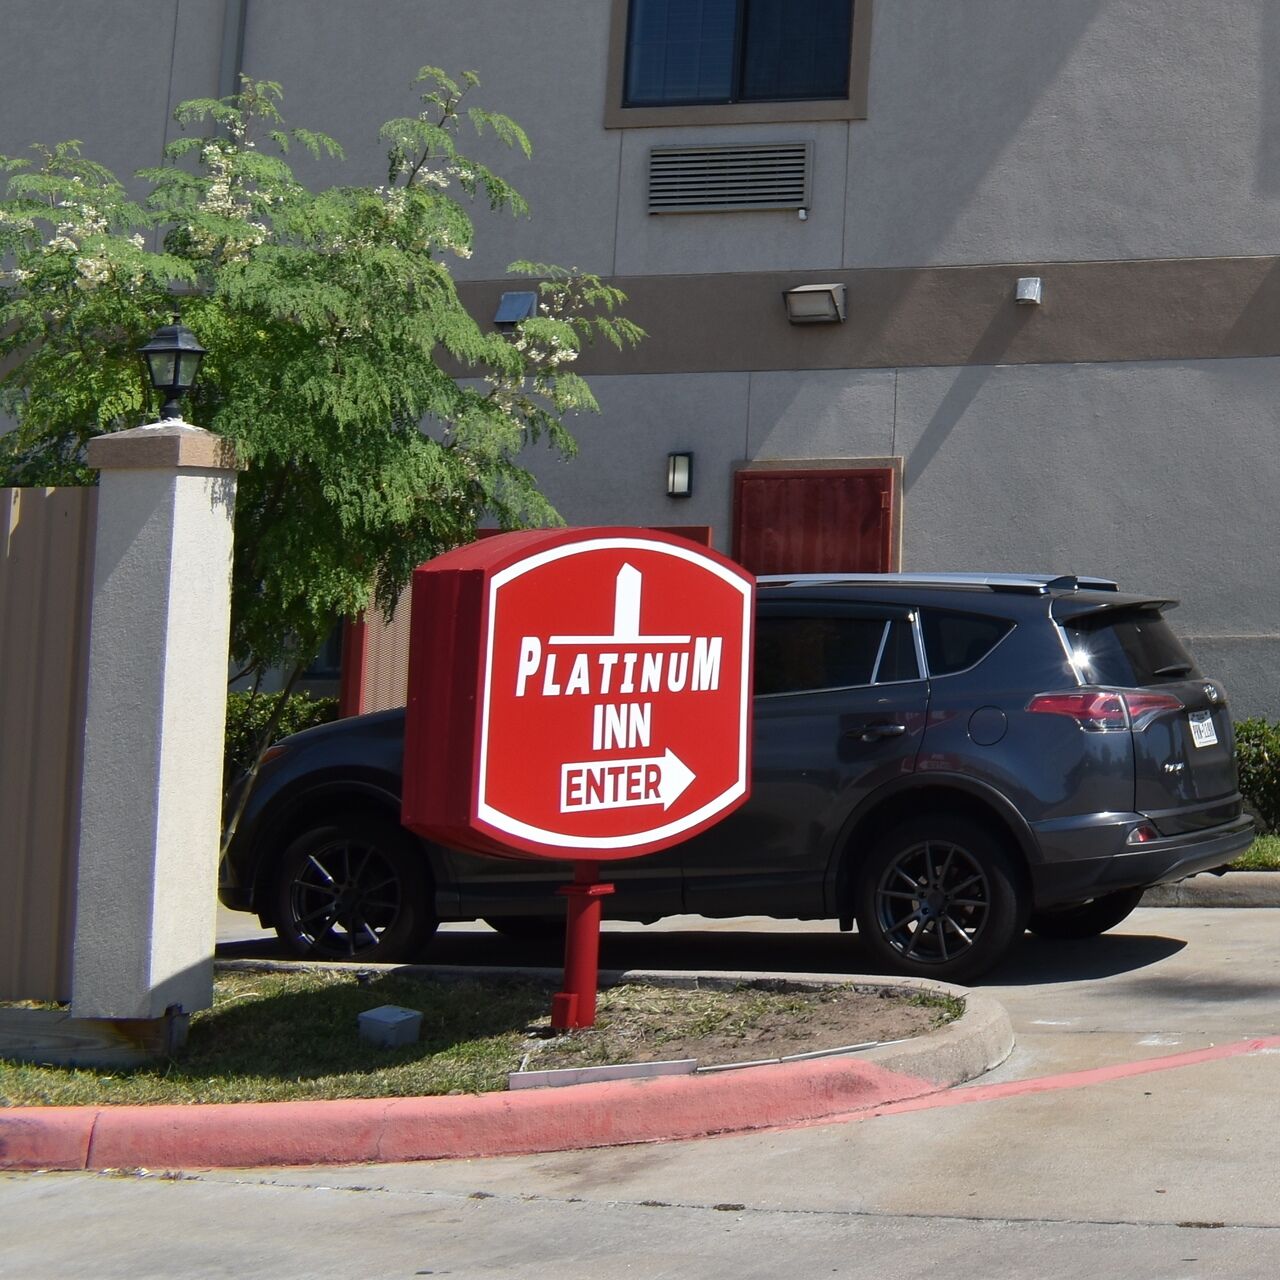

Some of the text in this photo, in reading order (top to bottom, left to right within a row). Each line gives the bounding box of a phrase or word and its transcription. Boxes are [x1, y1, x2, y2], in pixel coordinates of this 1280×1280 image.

[515, 636, 723, 697] PLATINUM
[592, 702, 651, 751] INN
[566, 764, 662, 806] ENTER
